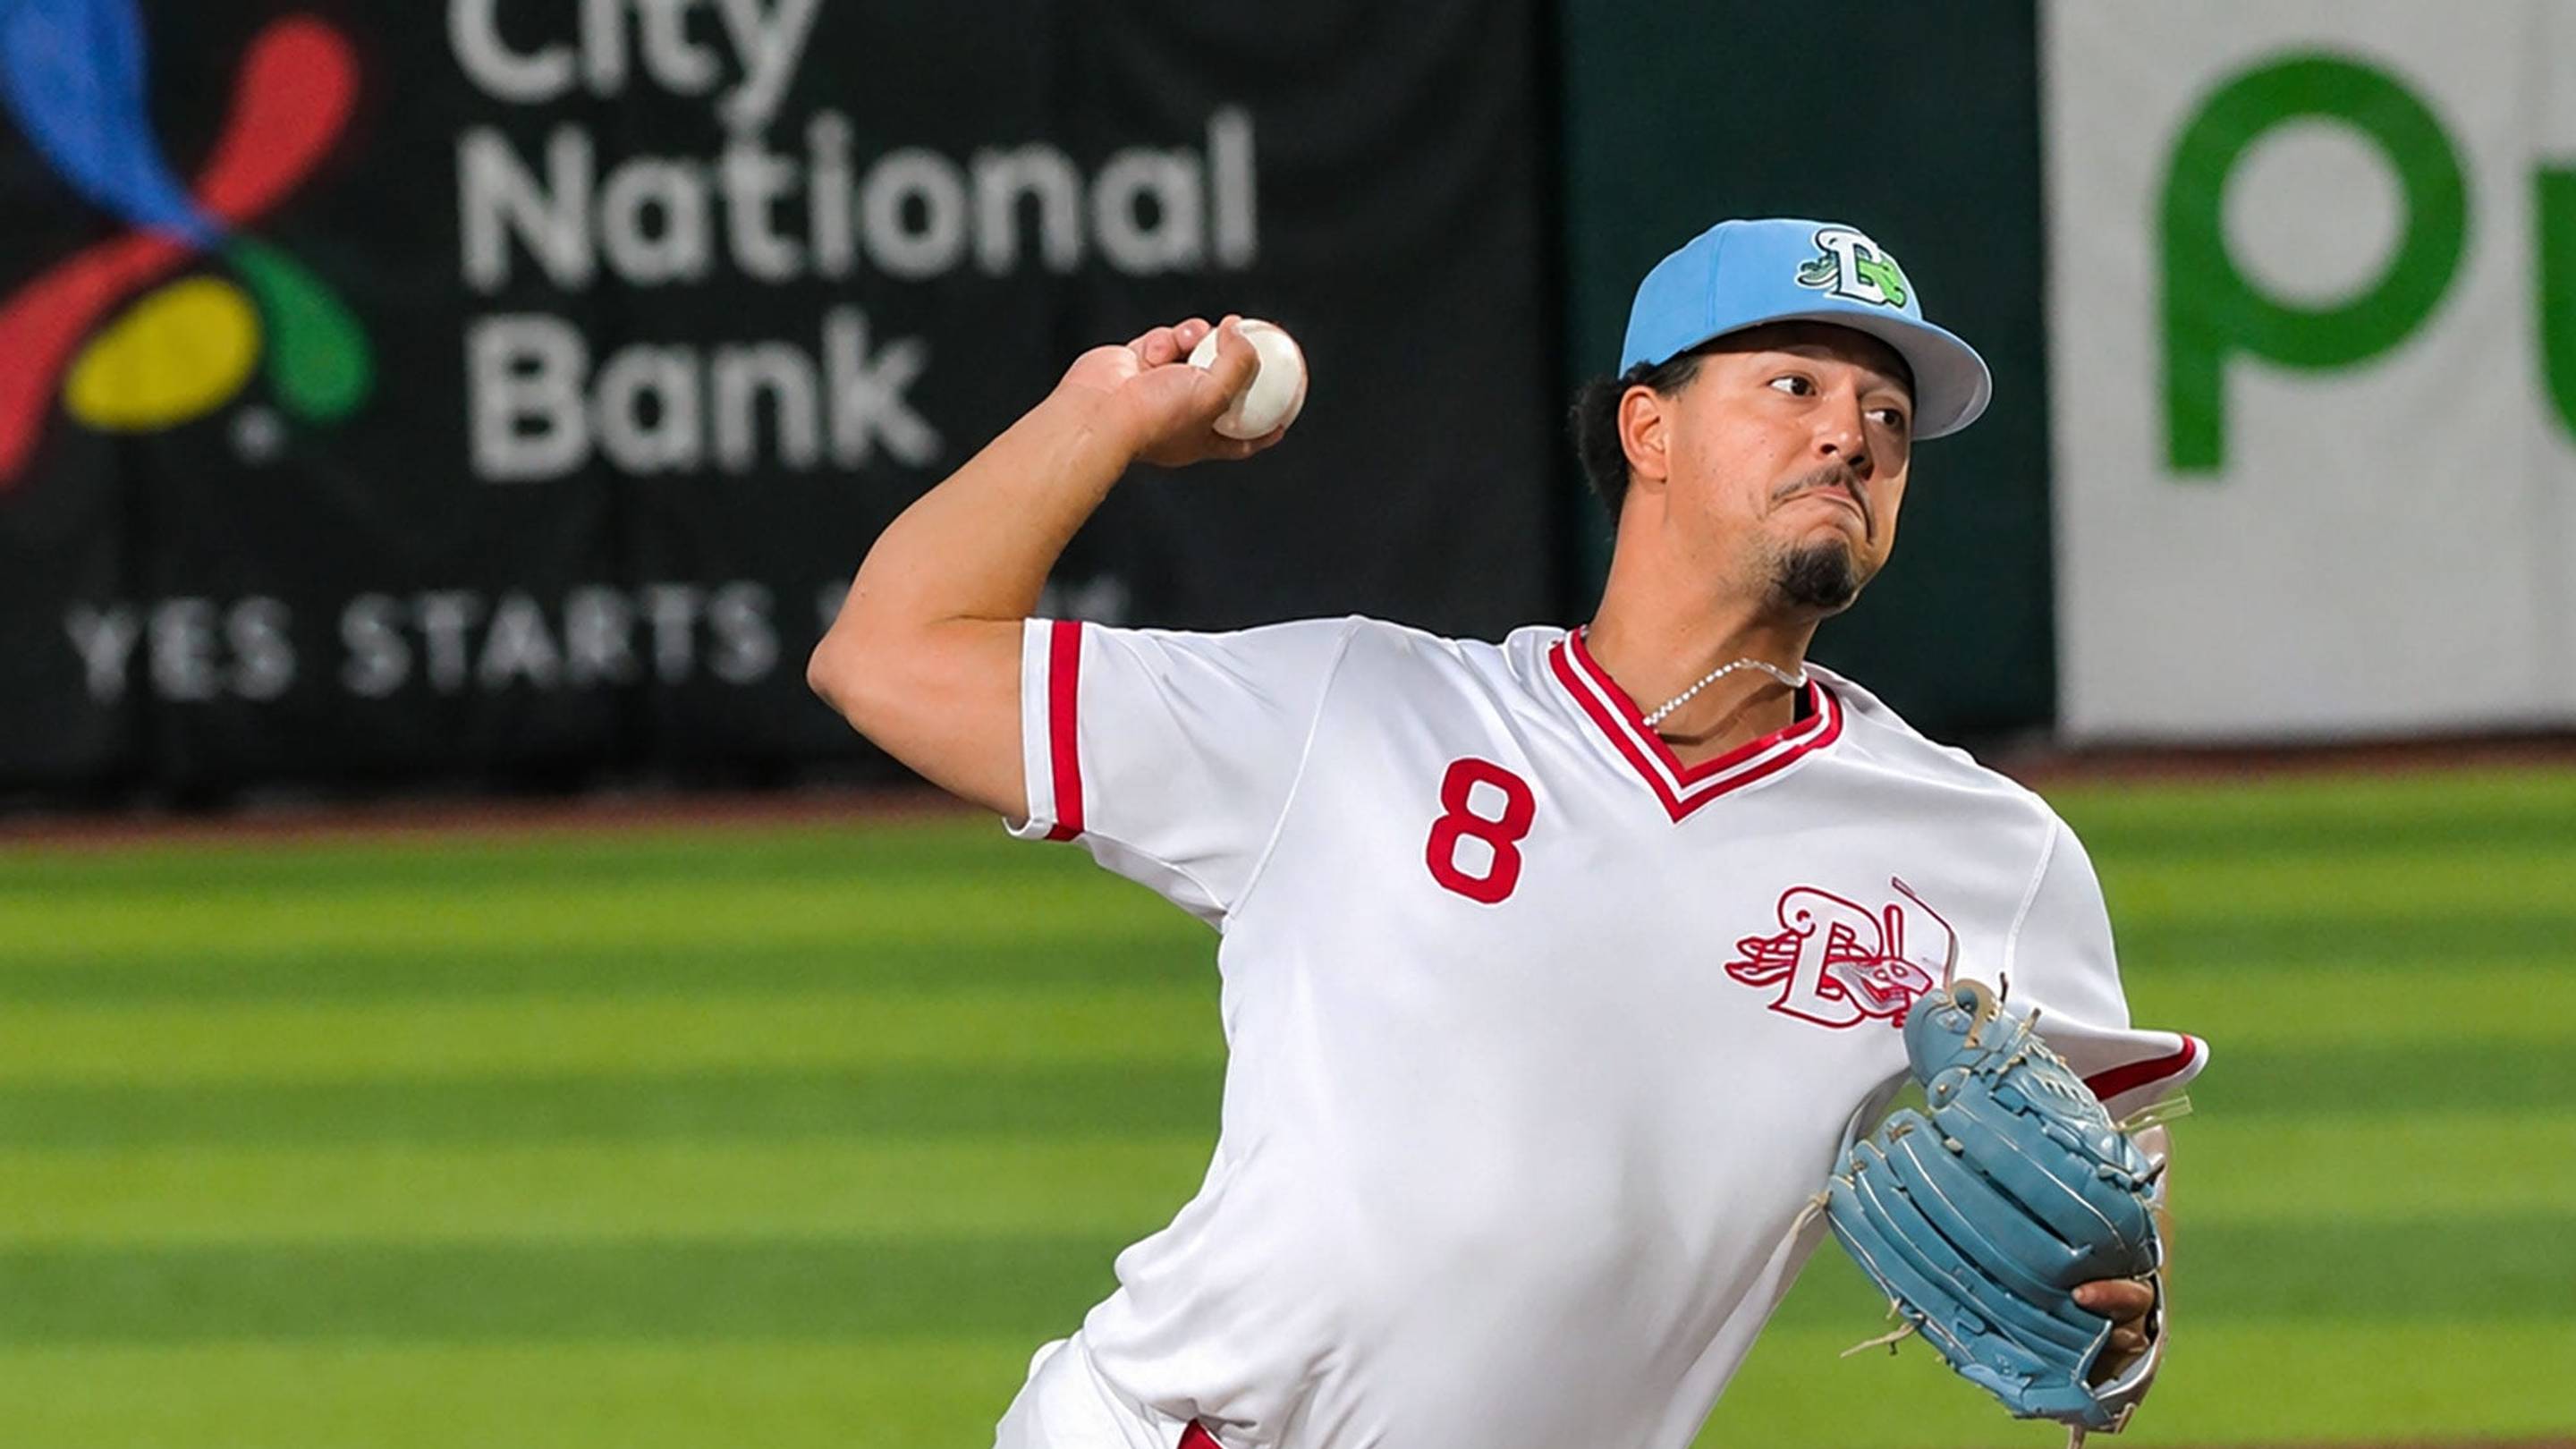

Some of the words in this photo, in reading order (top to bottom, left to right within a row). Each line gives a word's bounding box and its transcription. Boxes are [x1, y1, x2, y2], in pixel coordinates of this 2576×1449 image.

[450, 0, 814, 132] City
[458, 109, 1255, 286] National
[2163, 48, 2576, 477] p
[469, 308, 937, 479] Bank
[66, 597, 295, 701] YES
[340, 581, 780, 698] STARTS
[1426, 758, 1536, 904] 8
